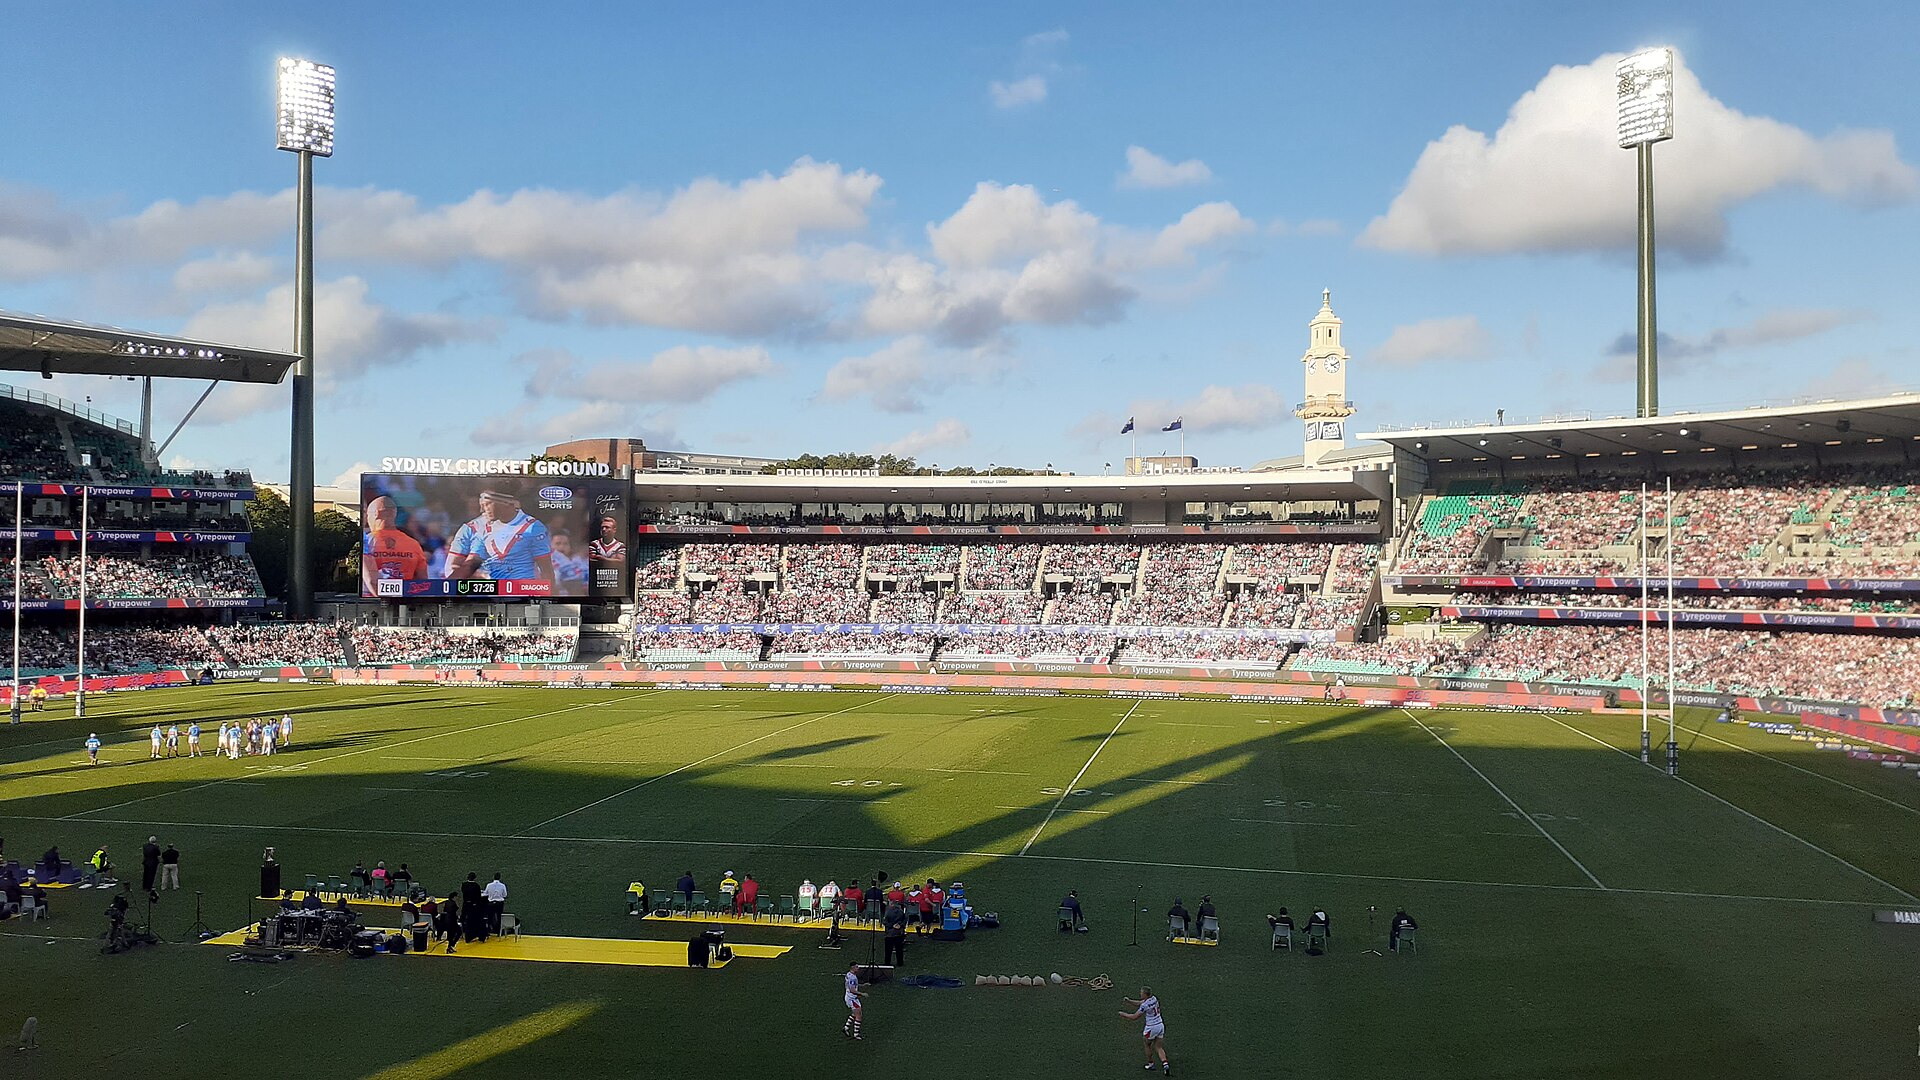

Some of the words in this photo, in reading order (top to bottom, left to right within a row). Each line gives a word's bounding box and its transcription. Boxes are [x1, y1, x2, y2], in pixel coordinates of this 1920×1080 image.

[382, 456, 451, 473] SYDNEY
[455, 458, 531, 474] CRICKET
[535, 460, 610, 476] GROUND
[88, 486, 135, 496] Tyrepower
[194, 489, 239, 499] Tyrepower
[678, 525, 719, 533] Tyrepower
[769, 526, 810, 534] Tyrepower
[860, 526, 900, 534] Tyrepower
[950, 526, 989, 534] Tyrepower
[1039, 526, 1078, 534] Tyrepower
[1223, 526, 1265, 534] Tyrepower
[1319, 525, 1364, 533] Tyrepower
[96, 531, 140, 541] Tyrepower
[195, 532, 236, 542] Tyrepower
[380, 581, 400, 593] ZERO
[443, 581, 450, 593] 0
[506, 581, 513, 593] 0
[1536, 577, 1580, 587] Tyrepower
[1742, 578, 1790, 589] Tyrepower
[1854, 579, 1904, 591] Tyrepower
[473, 582, 495, 593] 37:26
[107, 599, 152, 609] Tyrepower
[207, 597, 249, 607] Tyrepower
[1481, 607, 1524, 617] Tyrepower
[1579, 608, 1624, 619] Tyrepower
[1681, 611, 1727, 622] Tyrepower
[1788, 613, 1836, 625] Tyrepower
[543, 663, 589, 671] Tyrepower
[746, 661, 789, 671] Tyrepower
[843, 660, 885, 670] Tyrepower
[939, 661, 980, 671] Tyrepower
[1033, 662, 1076, 673] Tyrepower
[1131, 665, 1175, 675] Tyrepower
[212, 668, 263, 679] Tyrepower
[1231, 668, 1276, 679] Tyrepower
[1441, 678, 1489, 690] Tyrepower
